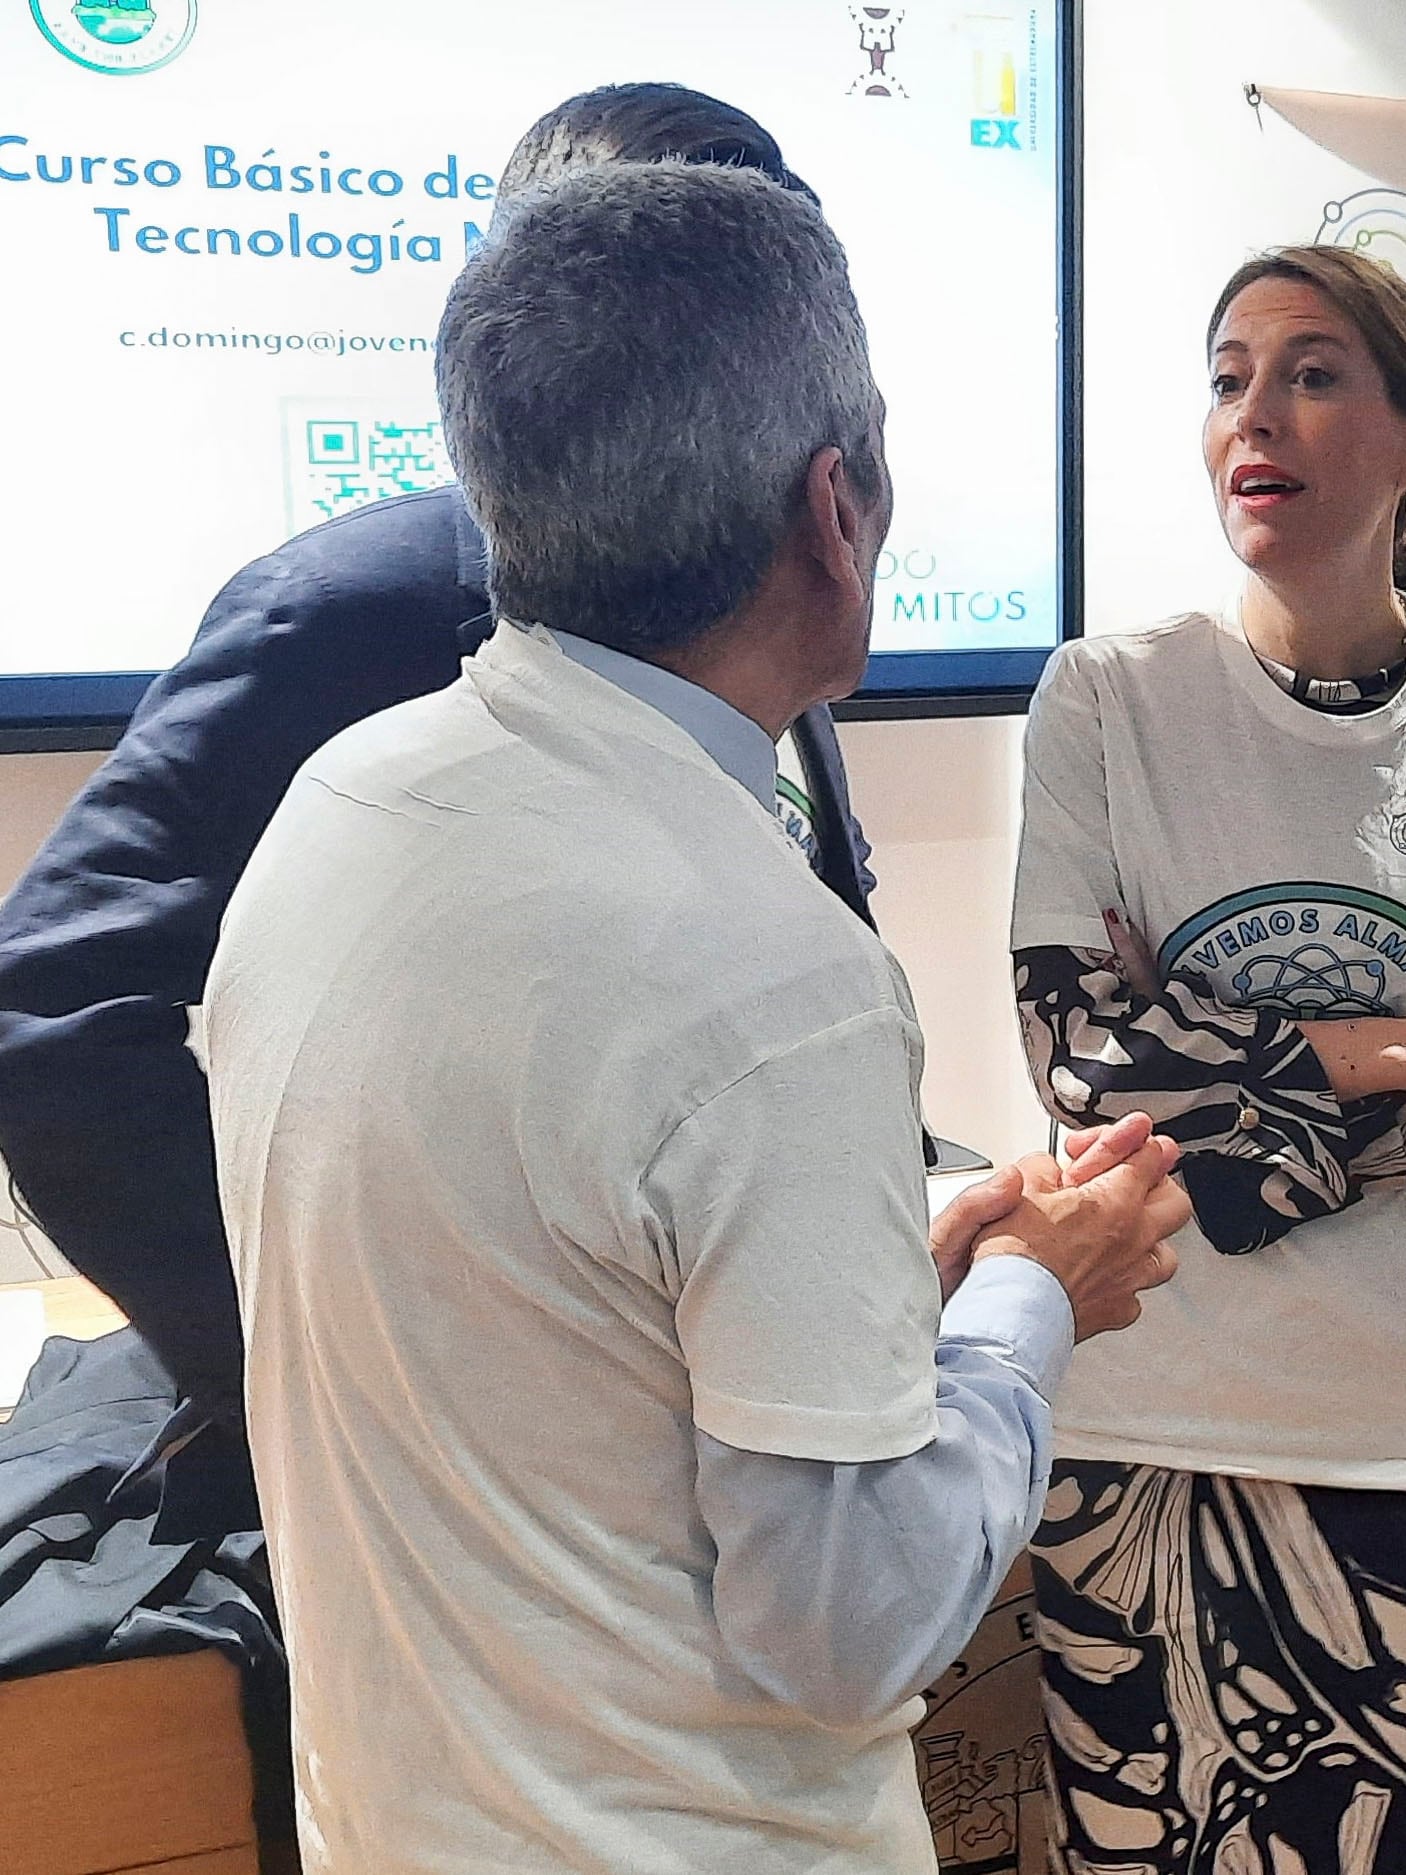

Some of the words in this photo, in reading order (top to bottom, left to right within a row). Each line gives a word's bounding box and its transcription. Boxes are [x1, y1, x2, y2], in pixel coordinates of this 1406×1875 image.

[0, 135, 181, 187] Curso
[204, 145, 403, 197] Básico
[424, 155, 496, 200] de
[94, 207, 441, 274] Tecnología
[119, 327, 438, 356] c.domingo@joven
[894, 591, 1026, 622] MITOS
[1194, 908, 1319, 970] VEMOS
